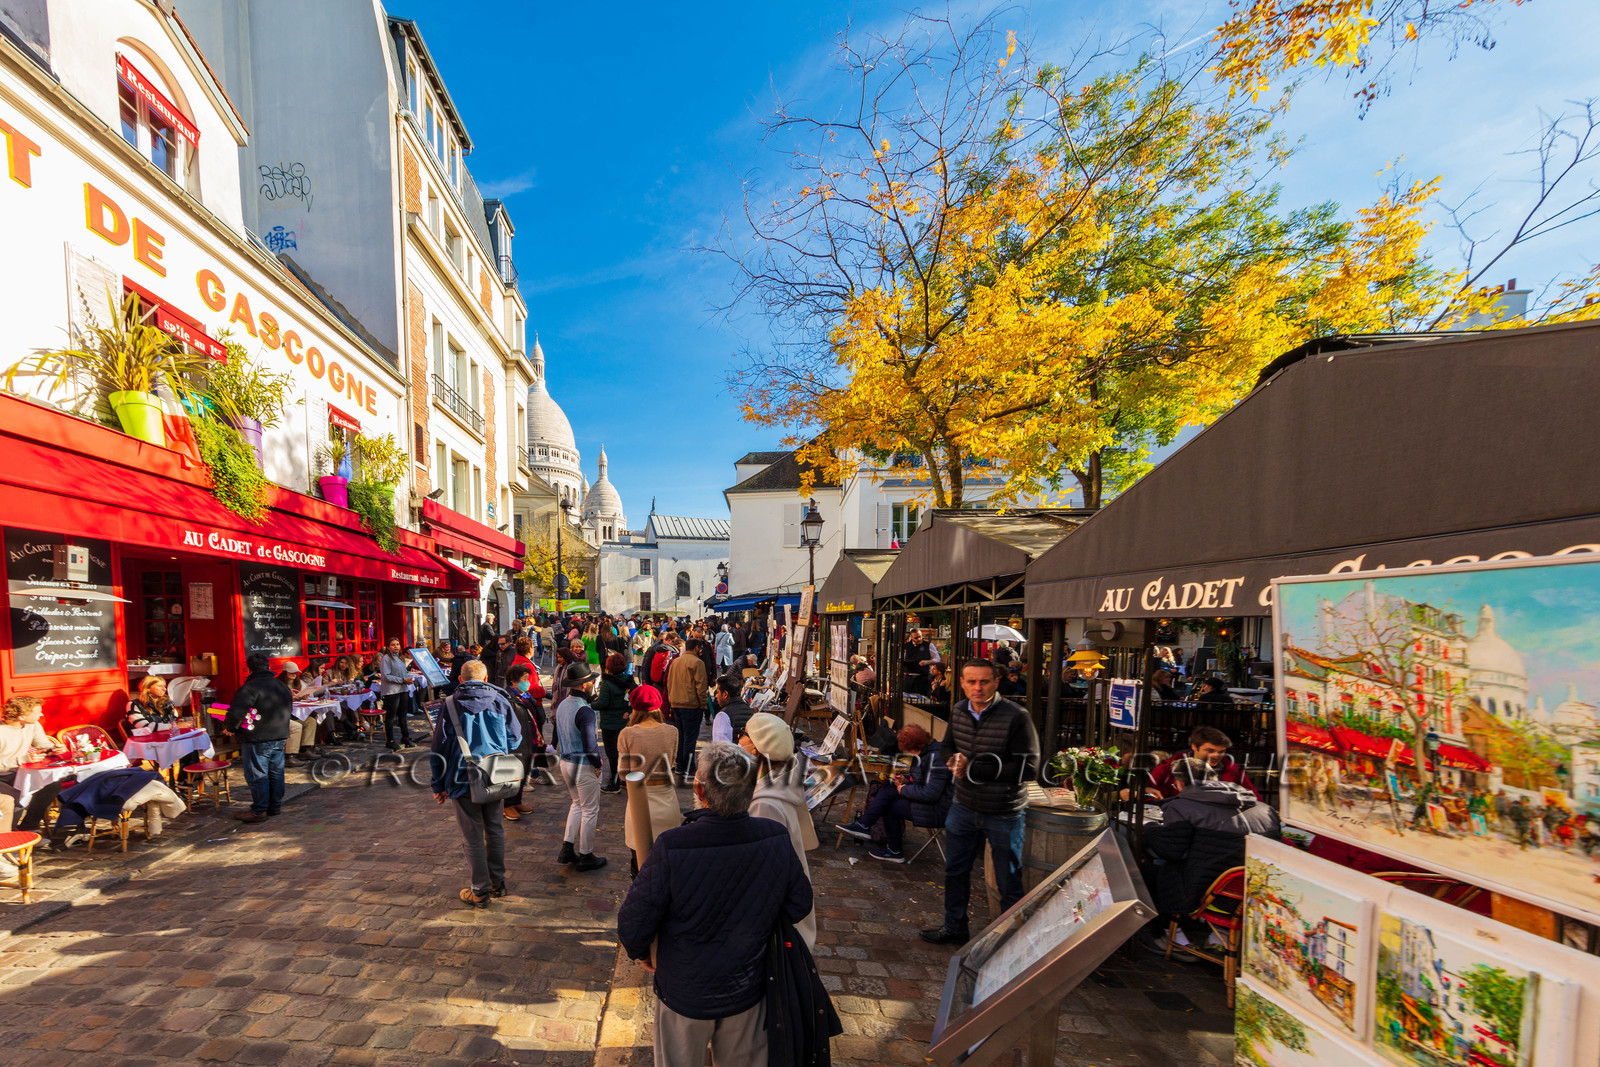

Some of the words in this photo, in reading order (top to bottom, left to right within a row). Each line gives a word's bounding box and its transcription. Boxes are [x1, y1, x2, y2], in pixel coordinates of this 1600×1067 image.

[126, 66, 196, 144] Restaurant
[83, 182, 167, 279] DE
[196, 269, 378, 417] GASCOGNE
[163, 320, 190, 342] salle
[195, 338, 206, 352] au
[209, 344, 222, 357] 1er
[184, 530, 203, 547] AU
[208, 532, 252, 556] CADET
[257, 545, 272, 558] de
[273, 545, 326, 568] GASCOGNE
[391, 568, 419, 583] Restaurant
[1099, 588, 1134, 612] AU
[1141, 576, 1245, 612] CADET
